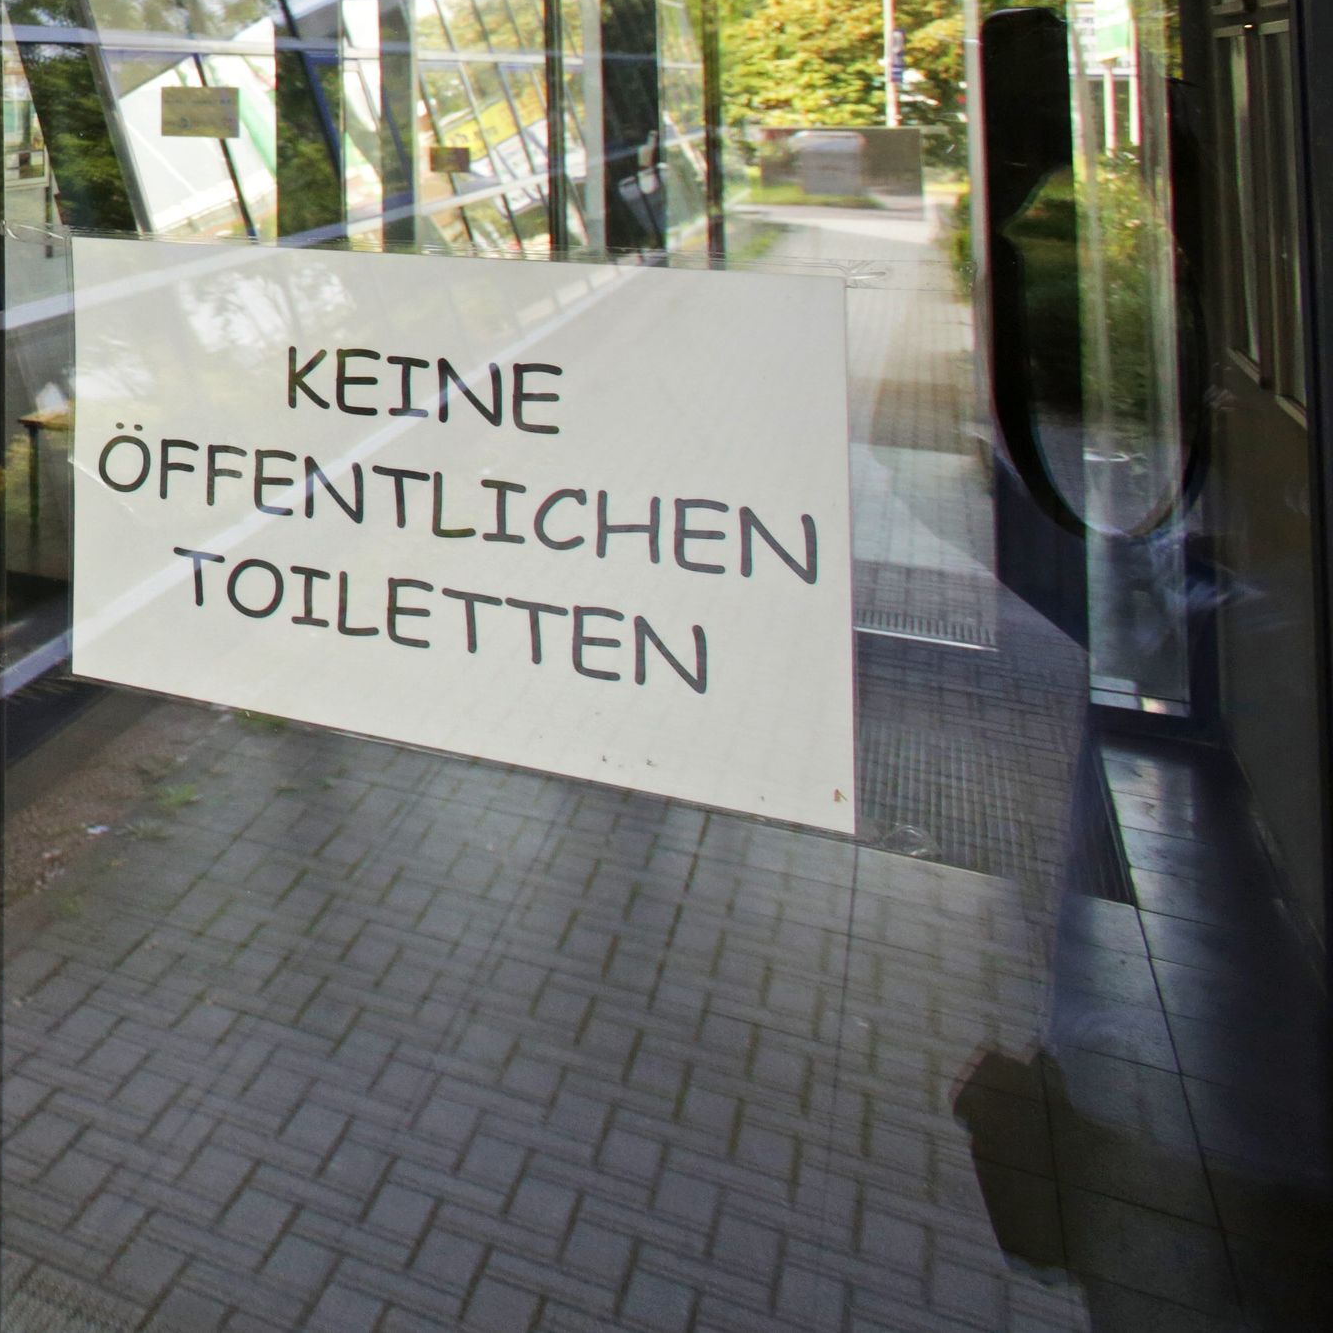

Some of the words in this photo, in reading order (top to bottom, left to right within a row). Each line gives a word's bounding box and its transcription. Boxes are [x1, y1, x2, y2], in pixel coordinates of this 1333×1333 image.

[287, 346, 564, 434] KEINE
[96, 421, 818, 585] ÖFFENTLICHEN
[173, 546, 707, 694] TOILETTEN
